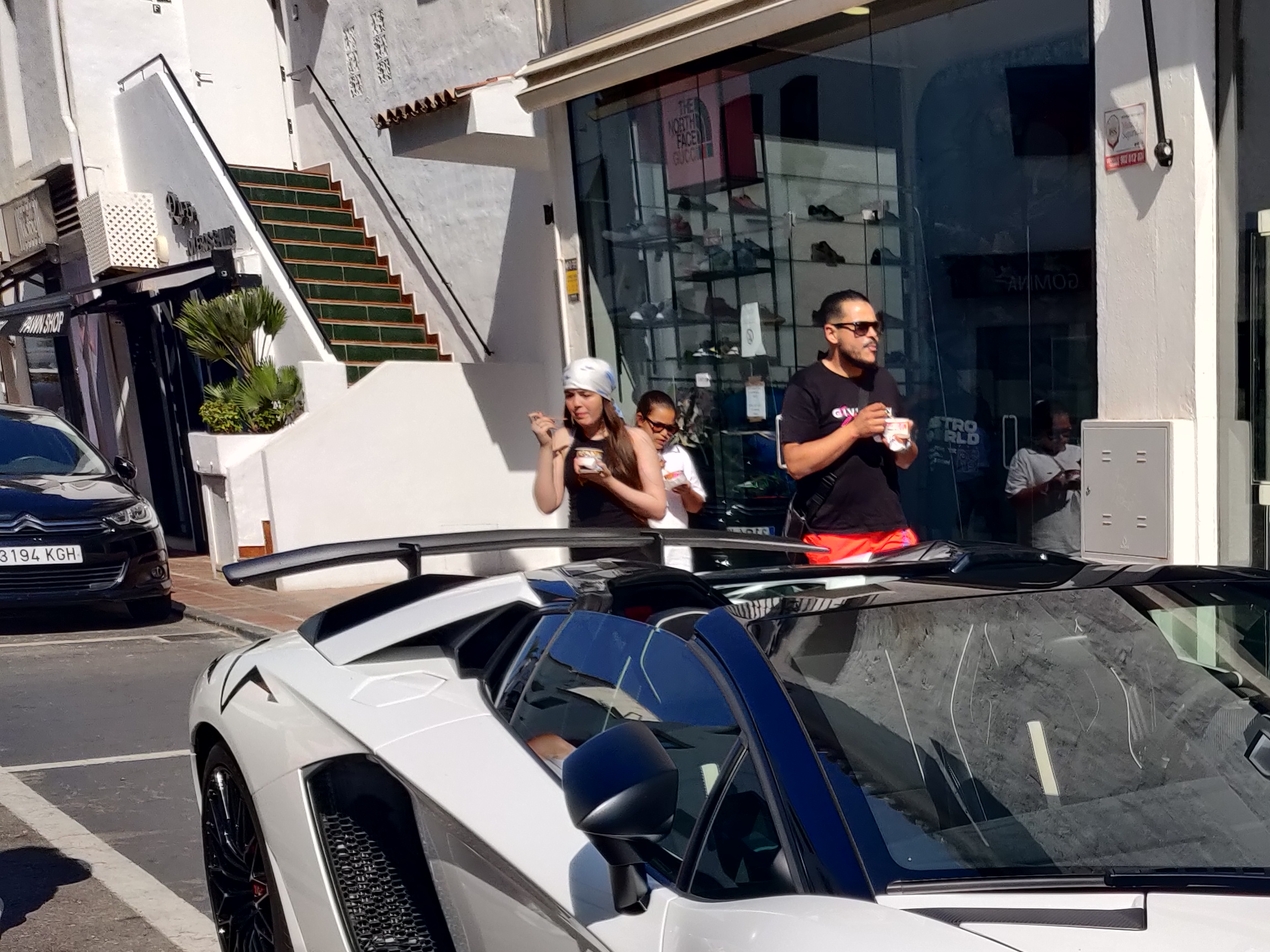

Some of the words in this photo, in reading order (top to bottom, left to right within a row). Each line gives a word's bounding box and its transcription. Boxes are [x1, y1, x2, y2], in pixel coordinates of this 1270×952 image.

[678, 98, 695, 115] THE
[668, 113, 696, 138] NORTH
[677, 130, 697, 149] FACE
[19, 314, 46, 334] PAWN
[43, 311, 64, 334] SHOP
[0, 549, 40, 562] 3194
[45, 547, 76, 561] KGH
